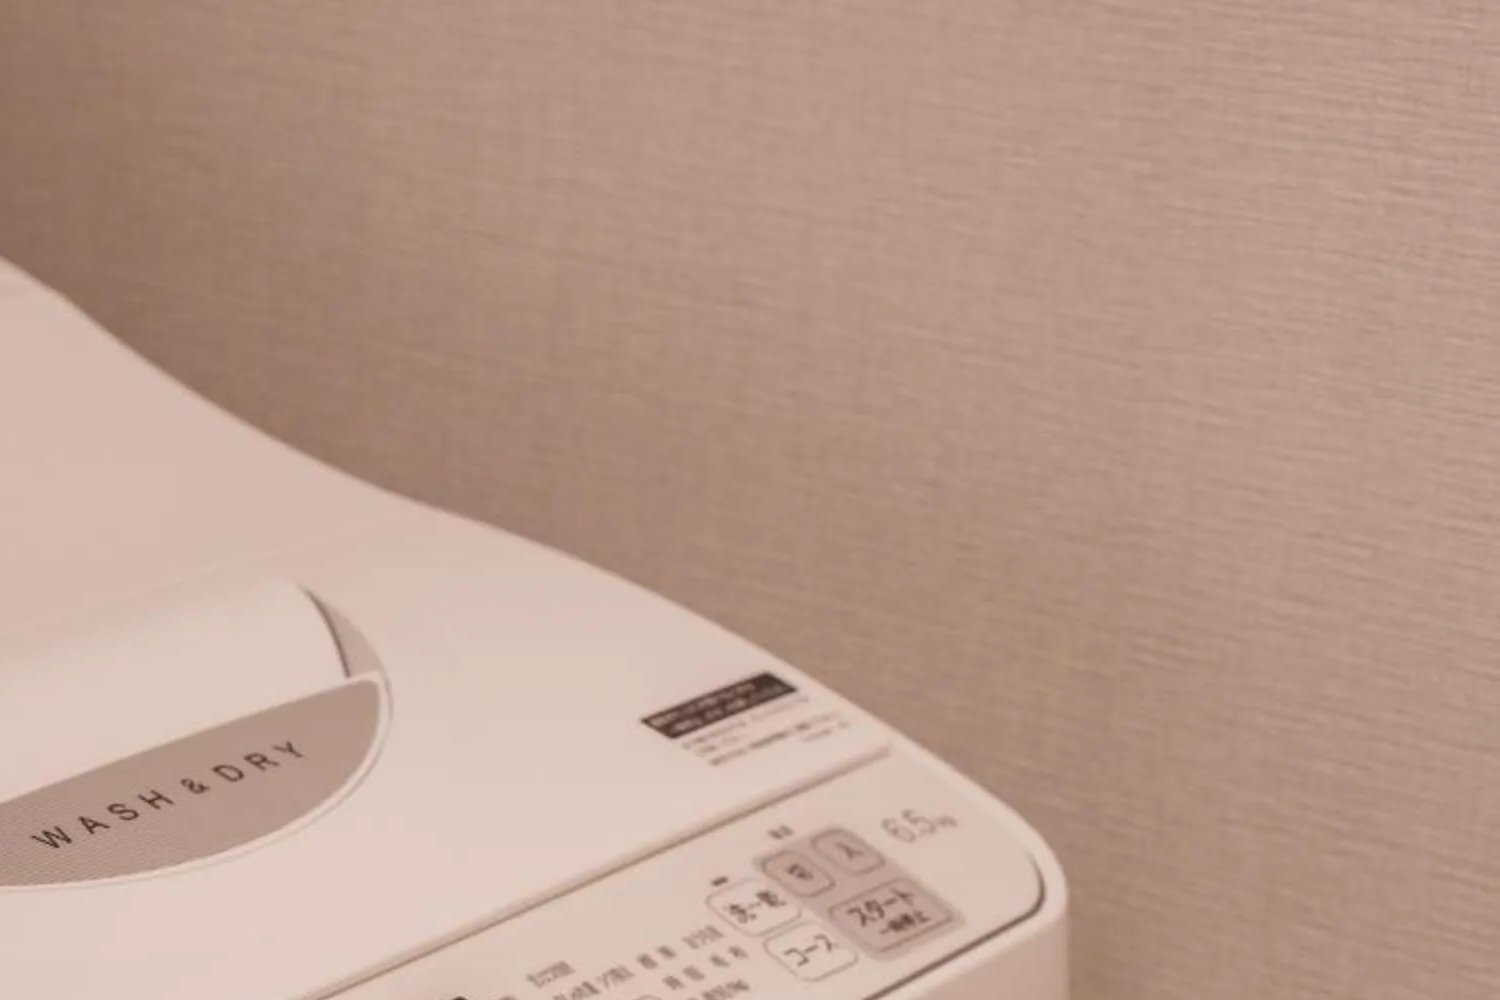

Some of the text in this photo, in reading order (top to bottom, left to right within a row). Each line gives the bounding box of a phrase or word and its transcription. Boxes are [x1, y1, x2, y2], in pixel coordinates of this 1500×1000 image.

[30, 740, 304, 849] WASH & DRY
[783, 933, 836, 966] コース
